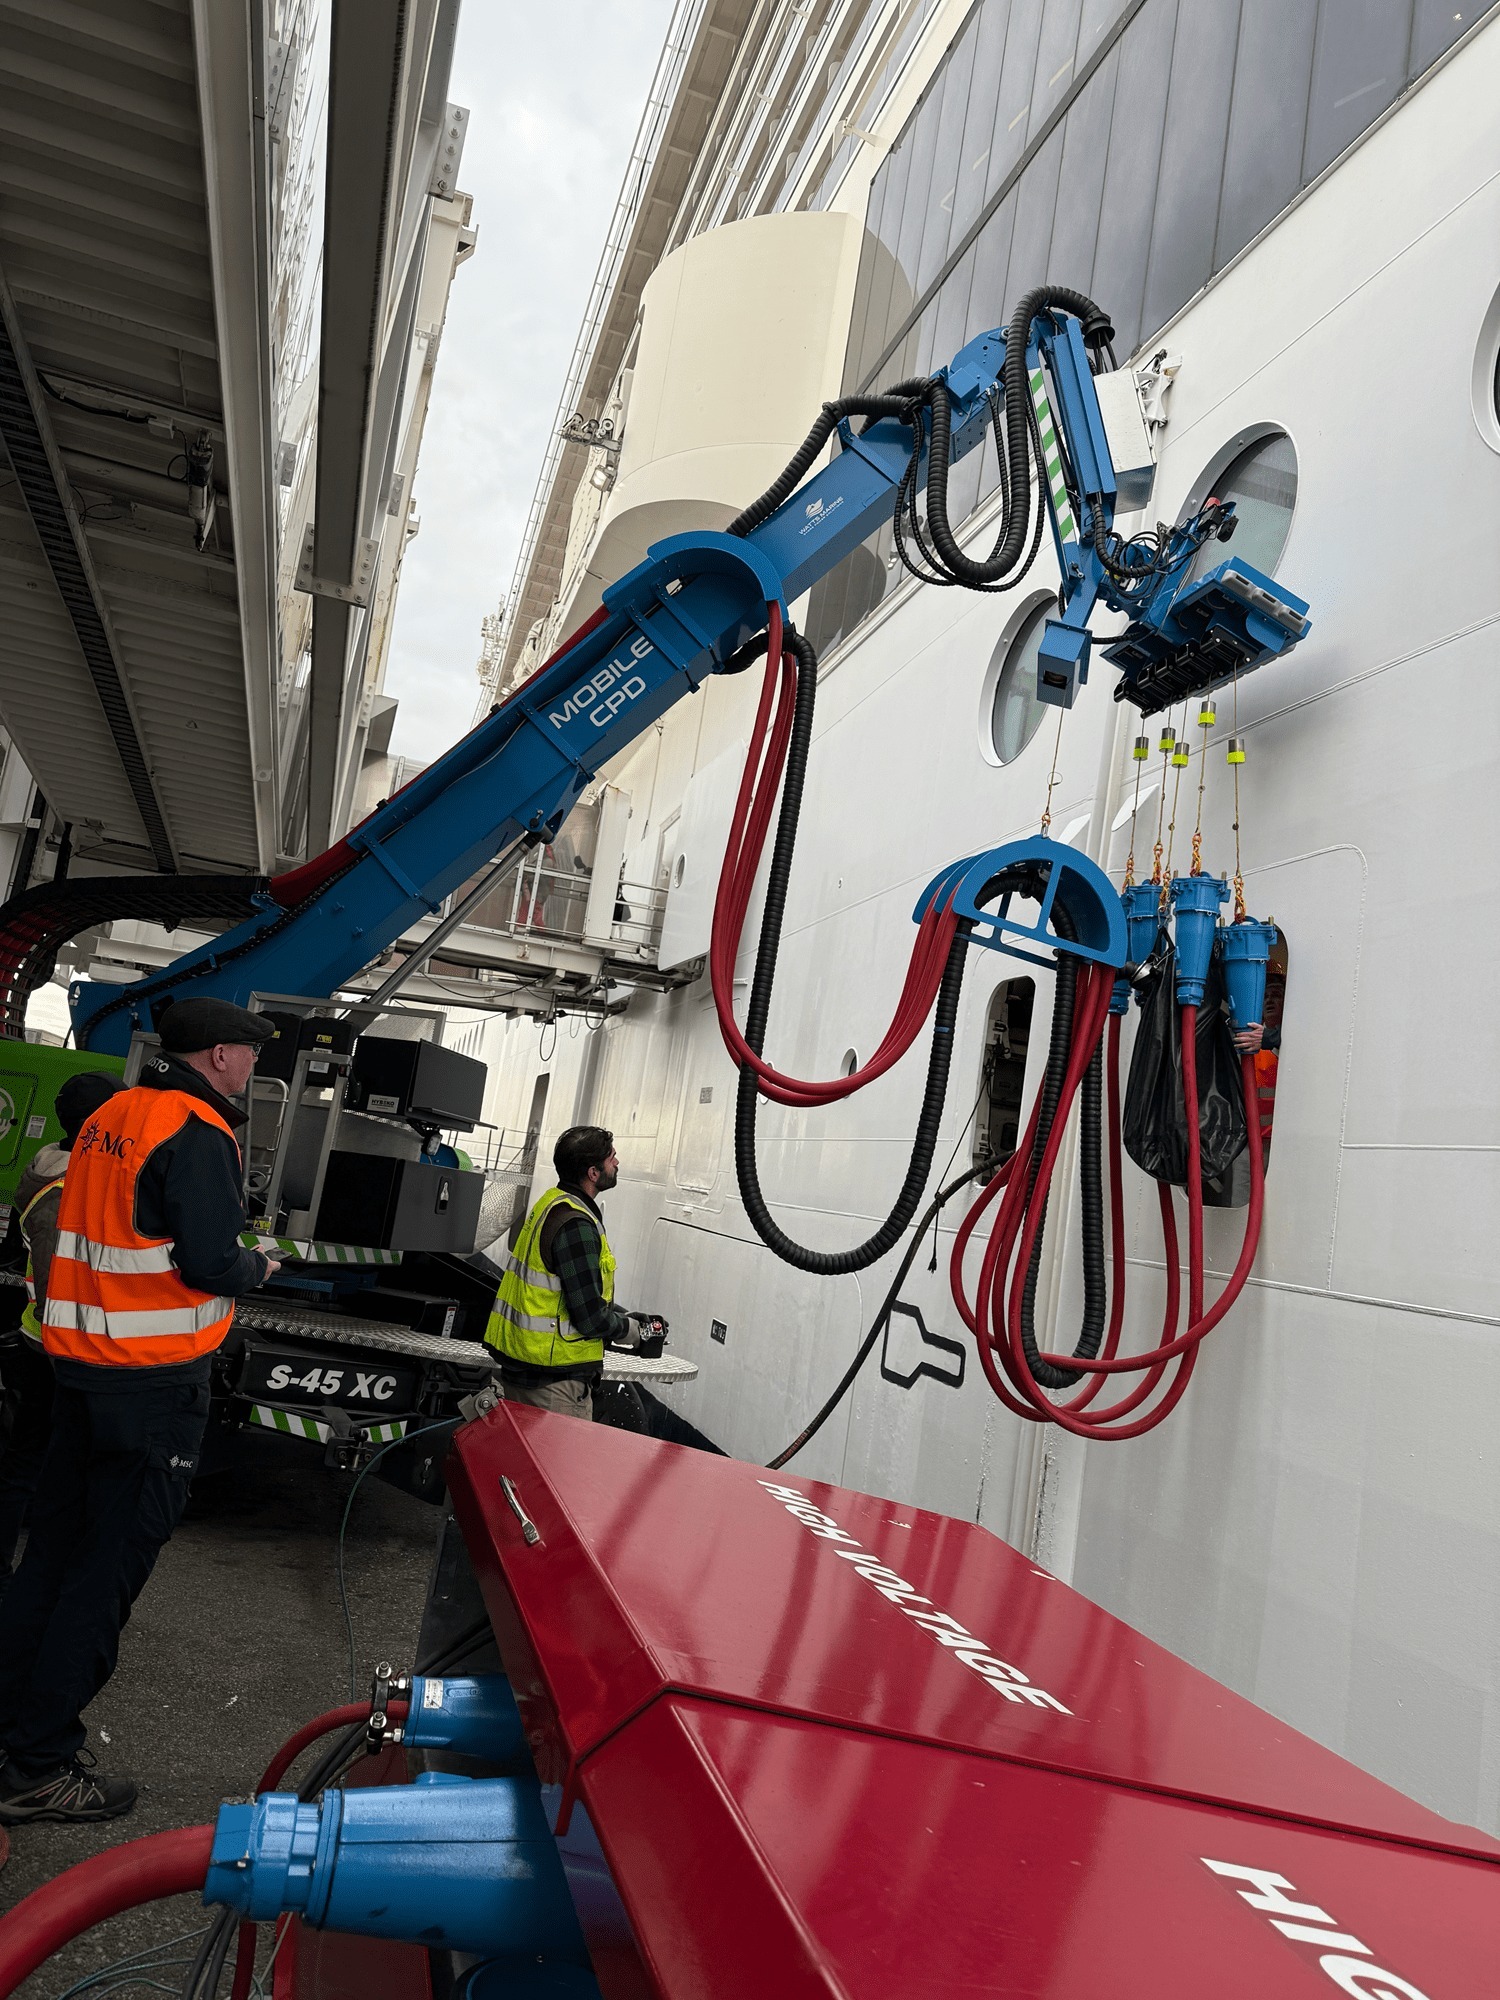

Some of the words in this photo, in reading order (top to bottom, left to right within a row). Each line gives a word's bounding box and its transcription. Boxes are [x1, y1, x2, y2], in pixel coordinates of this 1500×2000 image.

[820, 496, 844, 517] MARINE
[548, 635, 654, 730] MOBILE
[589, 676, 647, 727] CPD
[266, 1364, 344, 1395] S-45
[347, 1372, 397, 1400] XC
[179, 1459, 193, 1468] MSC
[756, 1479, 863, 1547] HIGH
[833, 1549, 1075, 1716] VOLTAGE
